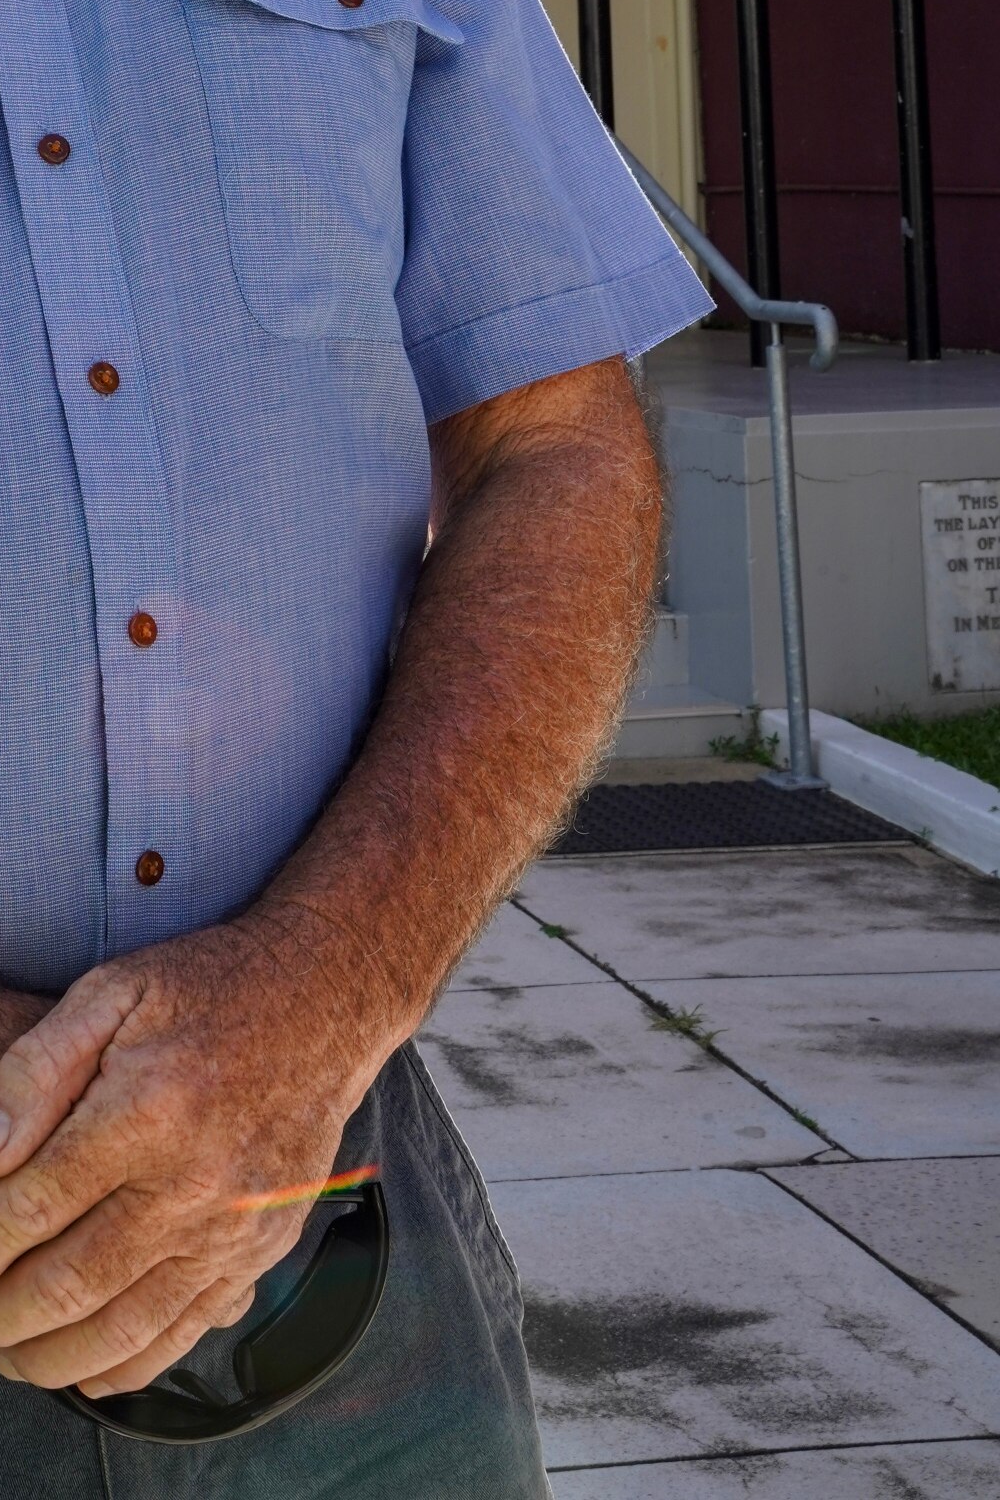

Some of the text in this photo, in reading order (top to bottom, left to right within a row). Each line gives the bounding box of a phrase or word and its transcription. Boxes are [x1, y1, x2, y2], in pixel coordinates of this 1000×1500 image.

[957, 494, 999, 511] THIS
[934, 518, 963, 533] THE
[977, 536, 997, 551] OF
[947, 558, 968, 572] ON
[953, 616, 972, 633] IN
